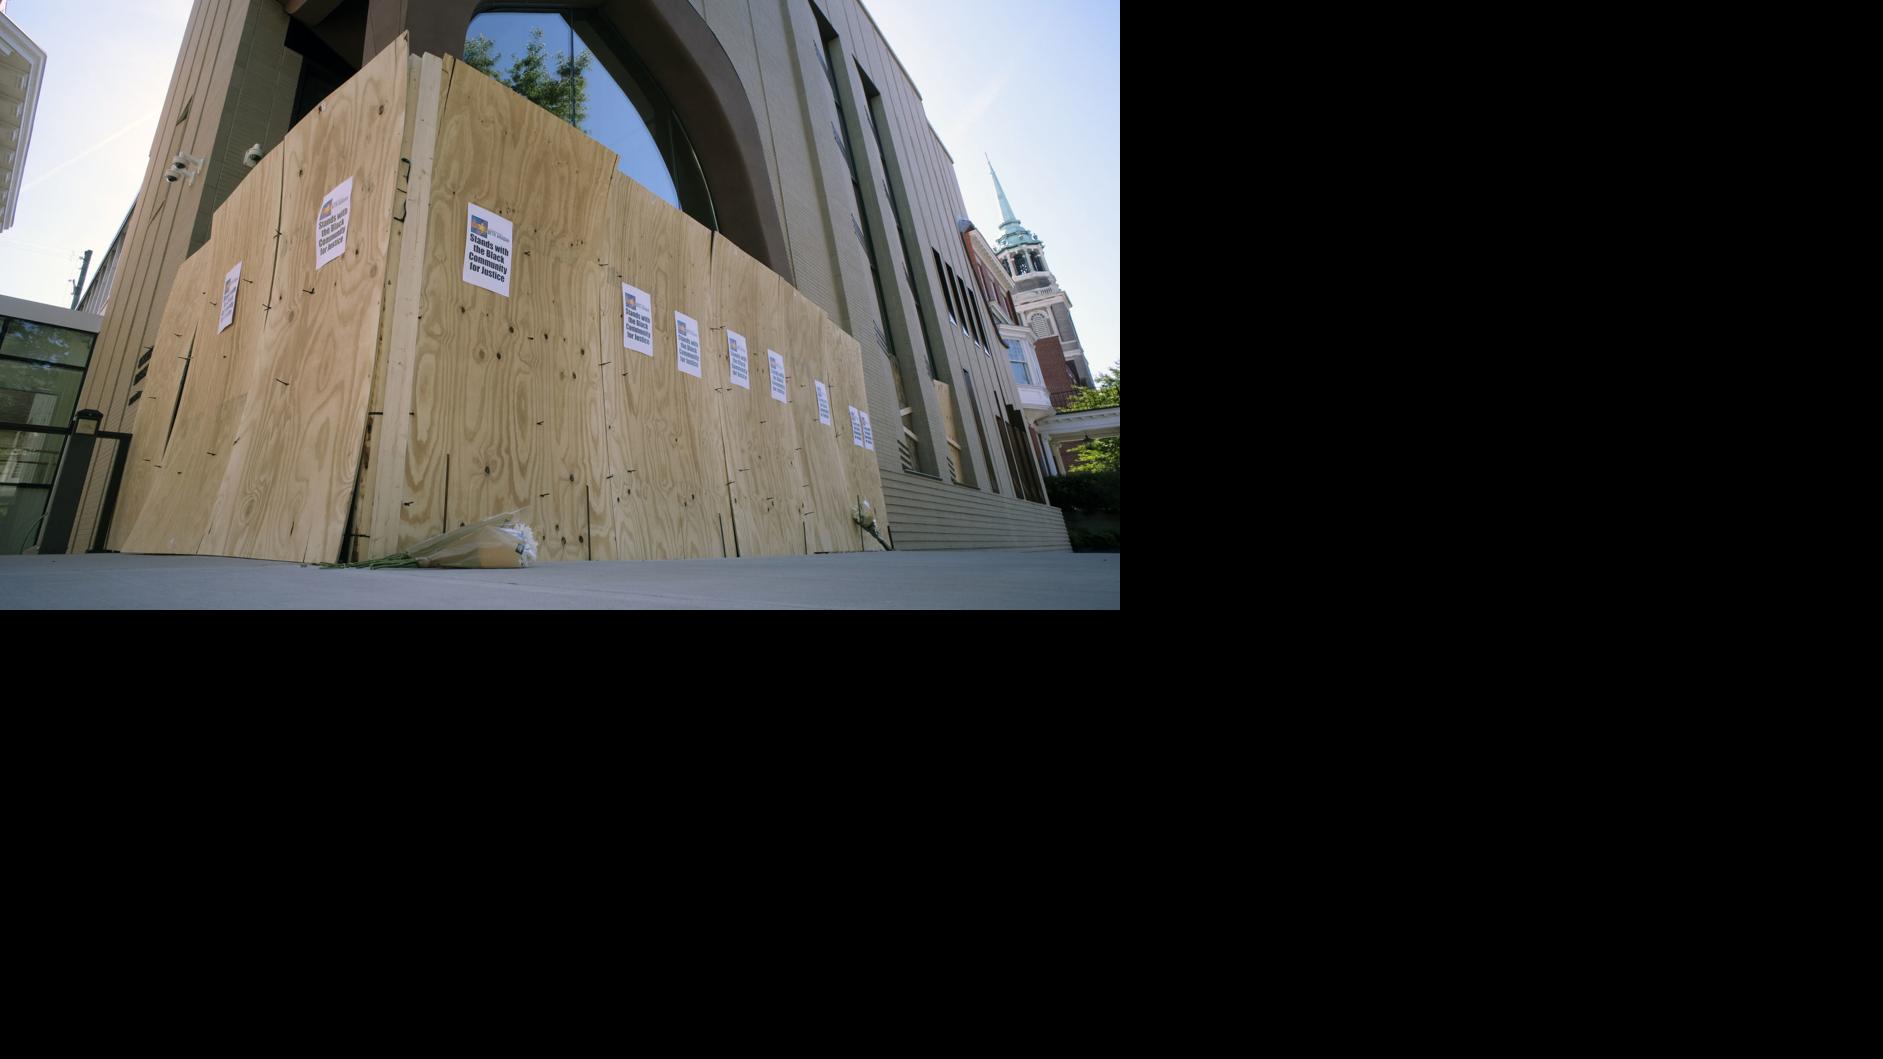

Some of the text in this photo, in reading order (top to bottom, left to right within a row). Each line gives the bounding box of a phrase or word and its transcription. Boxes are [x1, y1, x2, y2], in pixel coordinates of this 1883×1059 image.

[470, 233, 493, 250] Stands
[495, 245, 508, 256] with
[473, 245, 504, 264] the Black
[469, 252, 507, 274] Community
[470, 262, 504, 282] for Justice
